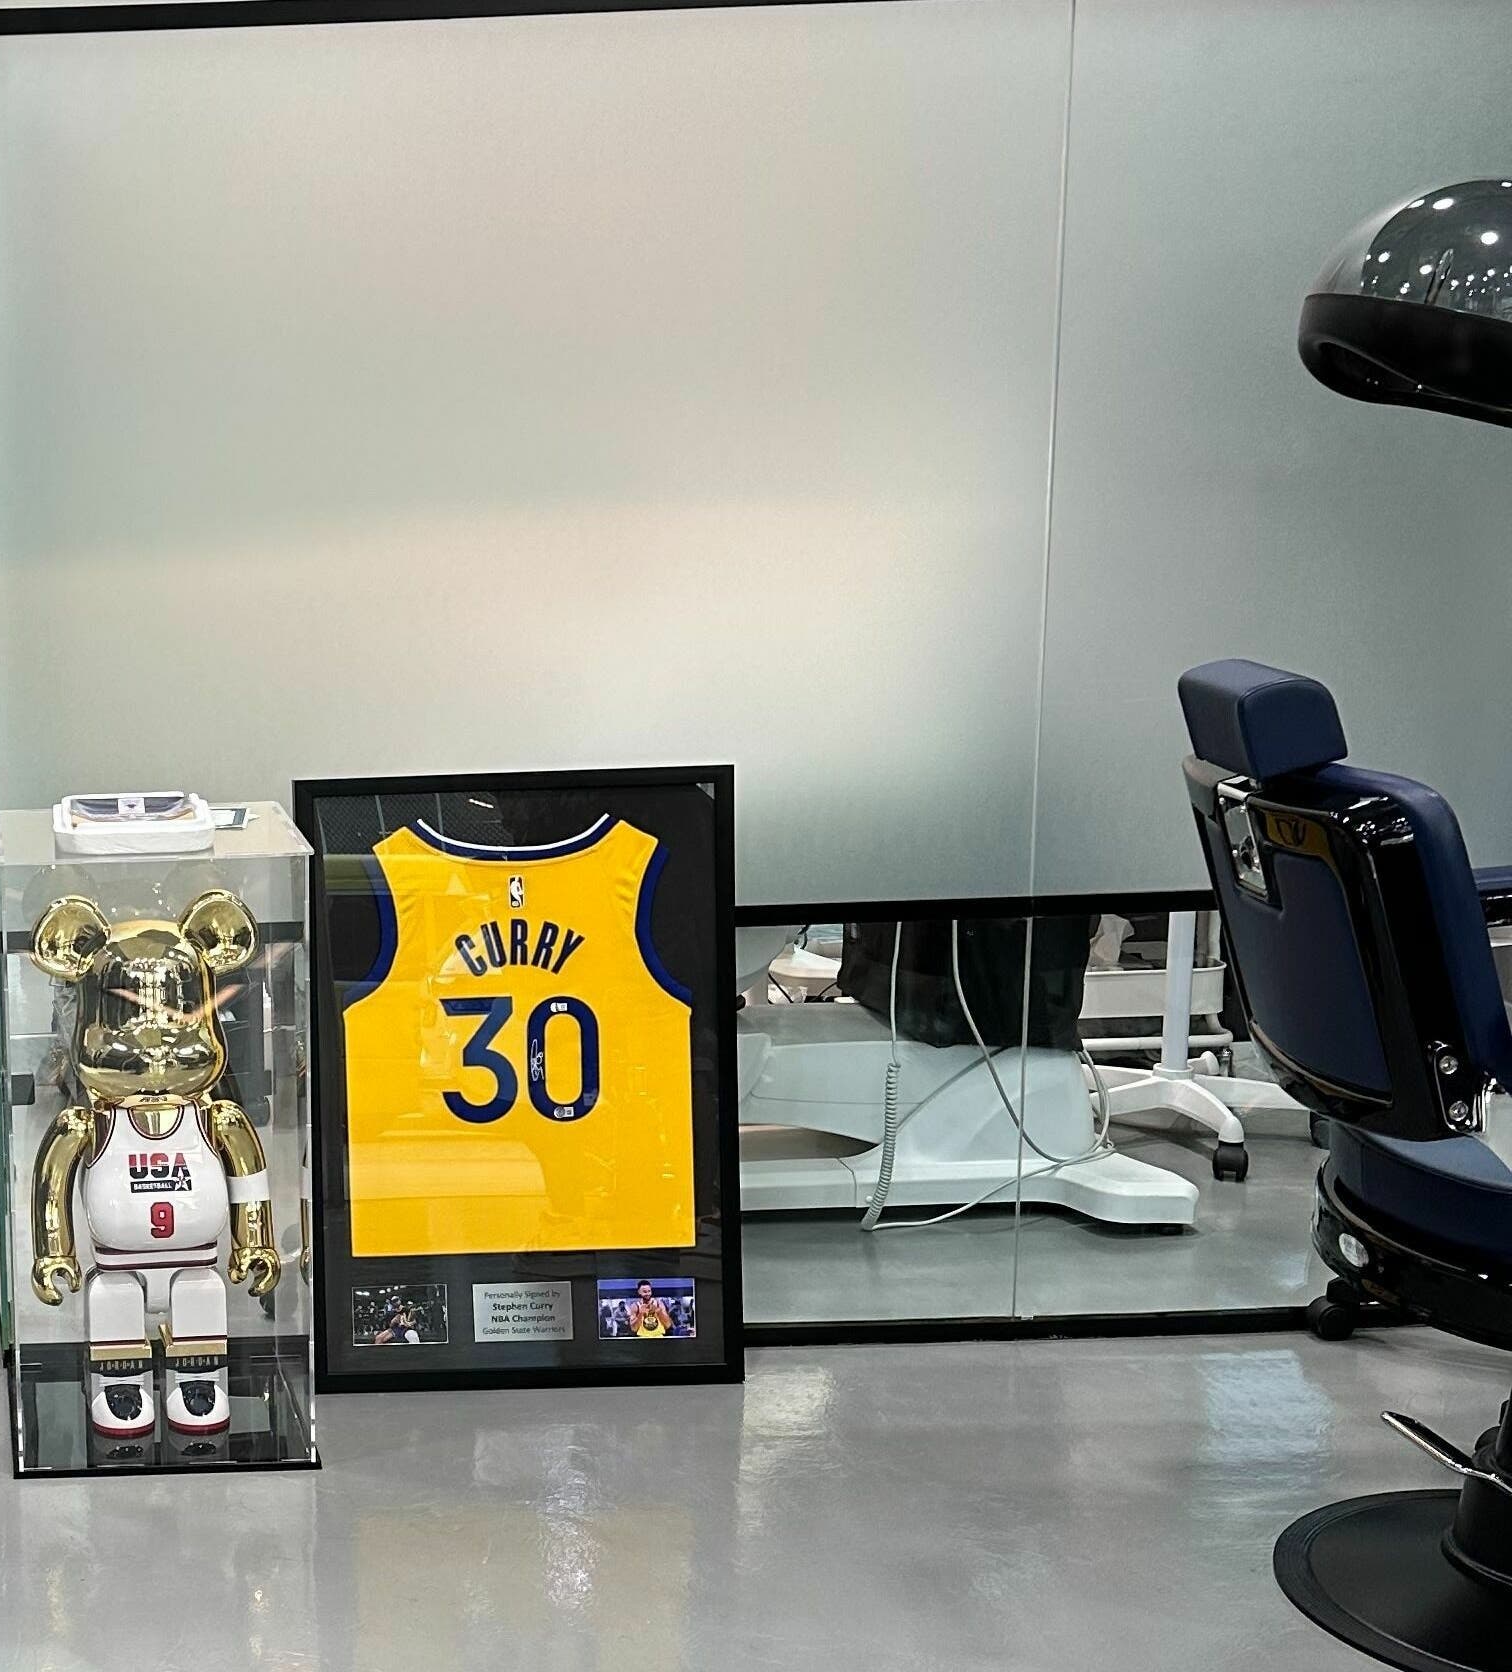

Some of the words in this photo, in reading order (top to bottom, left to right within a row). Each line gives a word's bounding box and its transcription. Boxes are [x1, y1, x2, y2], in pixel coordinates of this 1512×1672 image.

[455, 918, 585, 977] CURRY
[439, 996, 600, 1124] 30
[128, 1152, 191, 1179] USA
[150, 1201, 175, 1239] 9
[492, 1301, 528, 1312] Stephen
[529, 1301, 554, 1312] Curry
[491, 1314, 510, 1323] NBA
[512, 1313, 556, 1323] Champion
[99, 1359, 143, 1371] JORDAN
[175, 1356, 219, 1367] JORDAN
